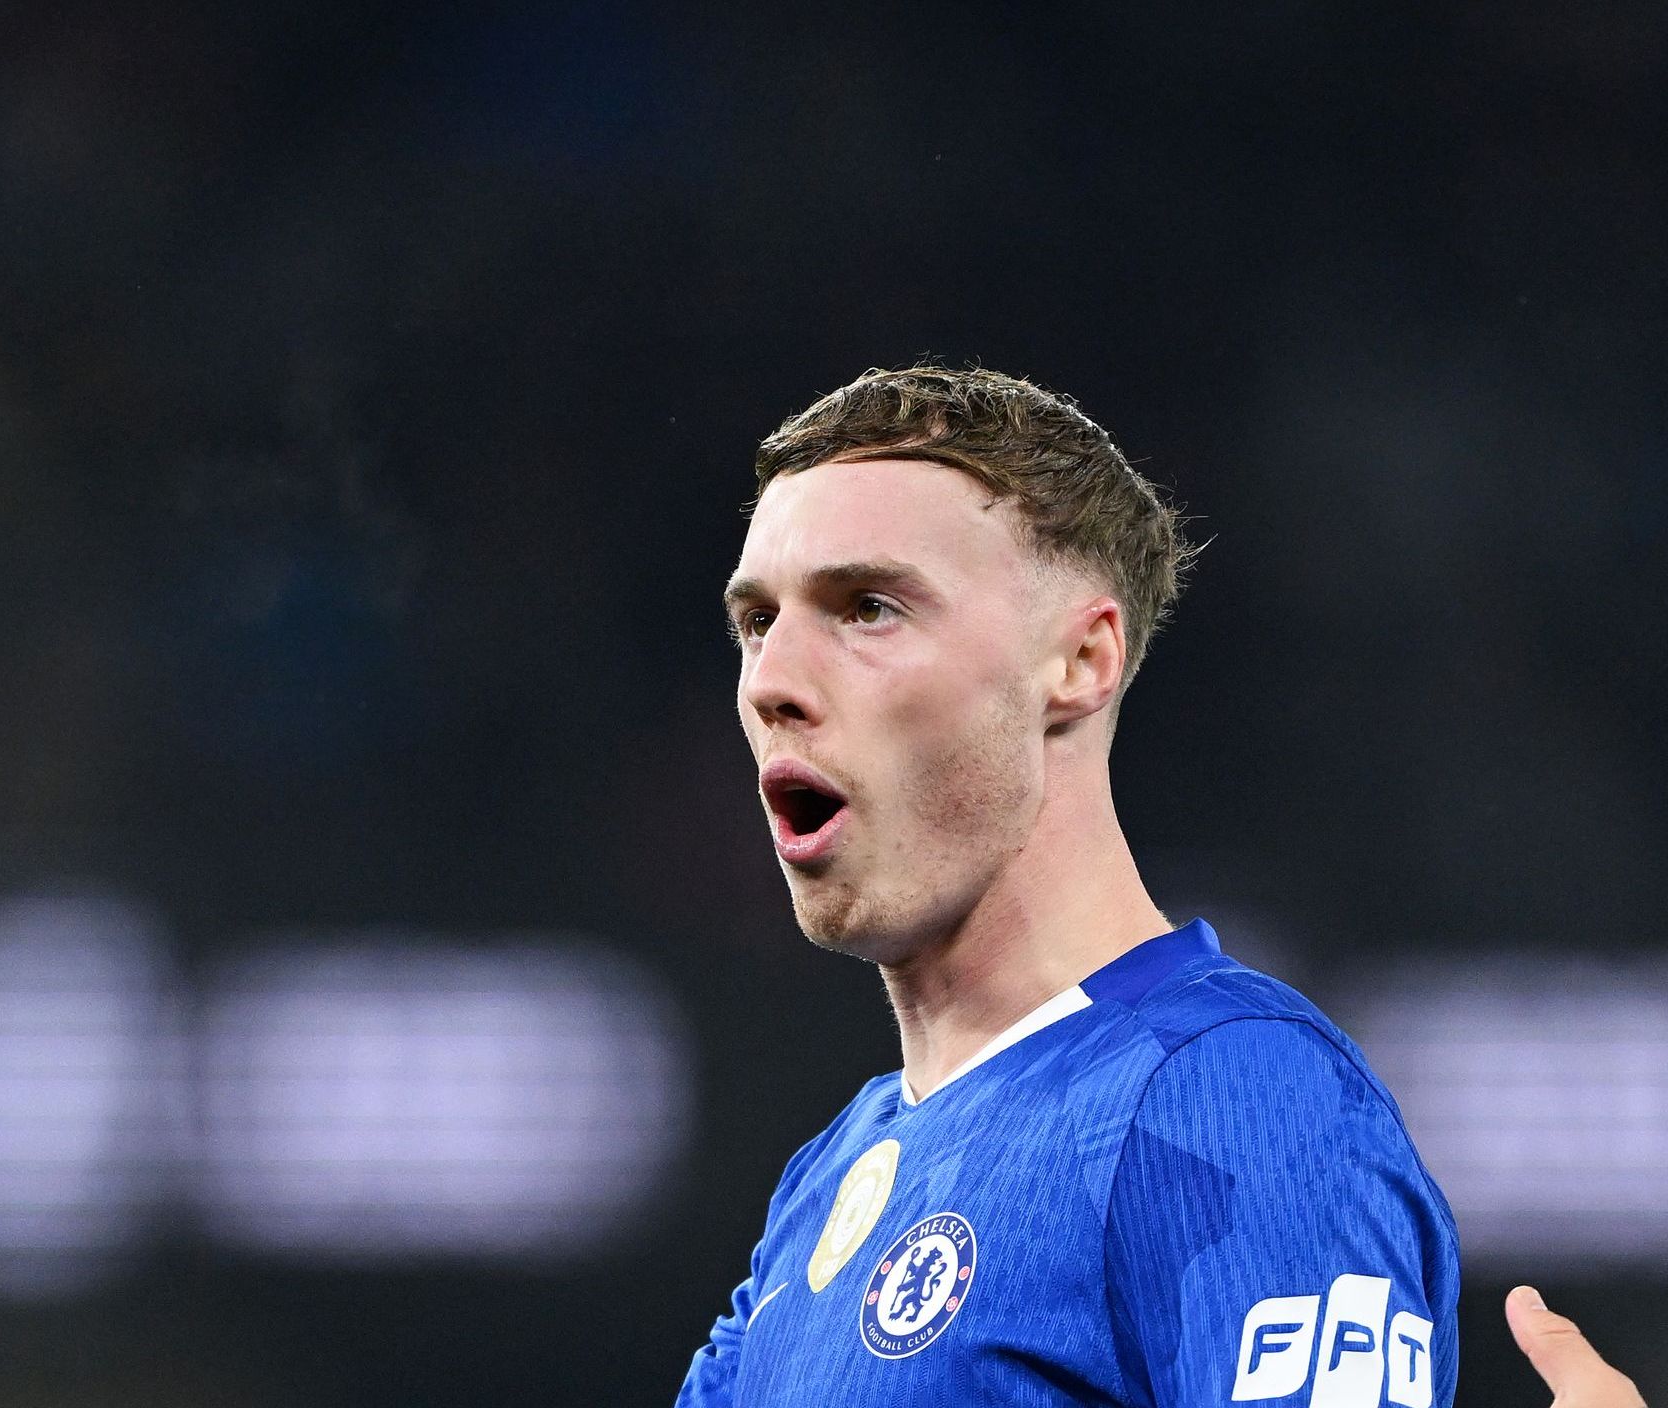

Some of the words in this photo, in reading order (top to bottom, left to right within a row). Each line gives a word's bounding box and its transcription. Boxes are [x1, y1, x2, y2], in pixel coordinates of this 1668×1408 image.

[906, 1219, 970, 1250] CHELSEA
[867, 1321, 902, 1350] FOOTBALL
[907, 1327, 933, 1348] CLUB
